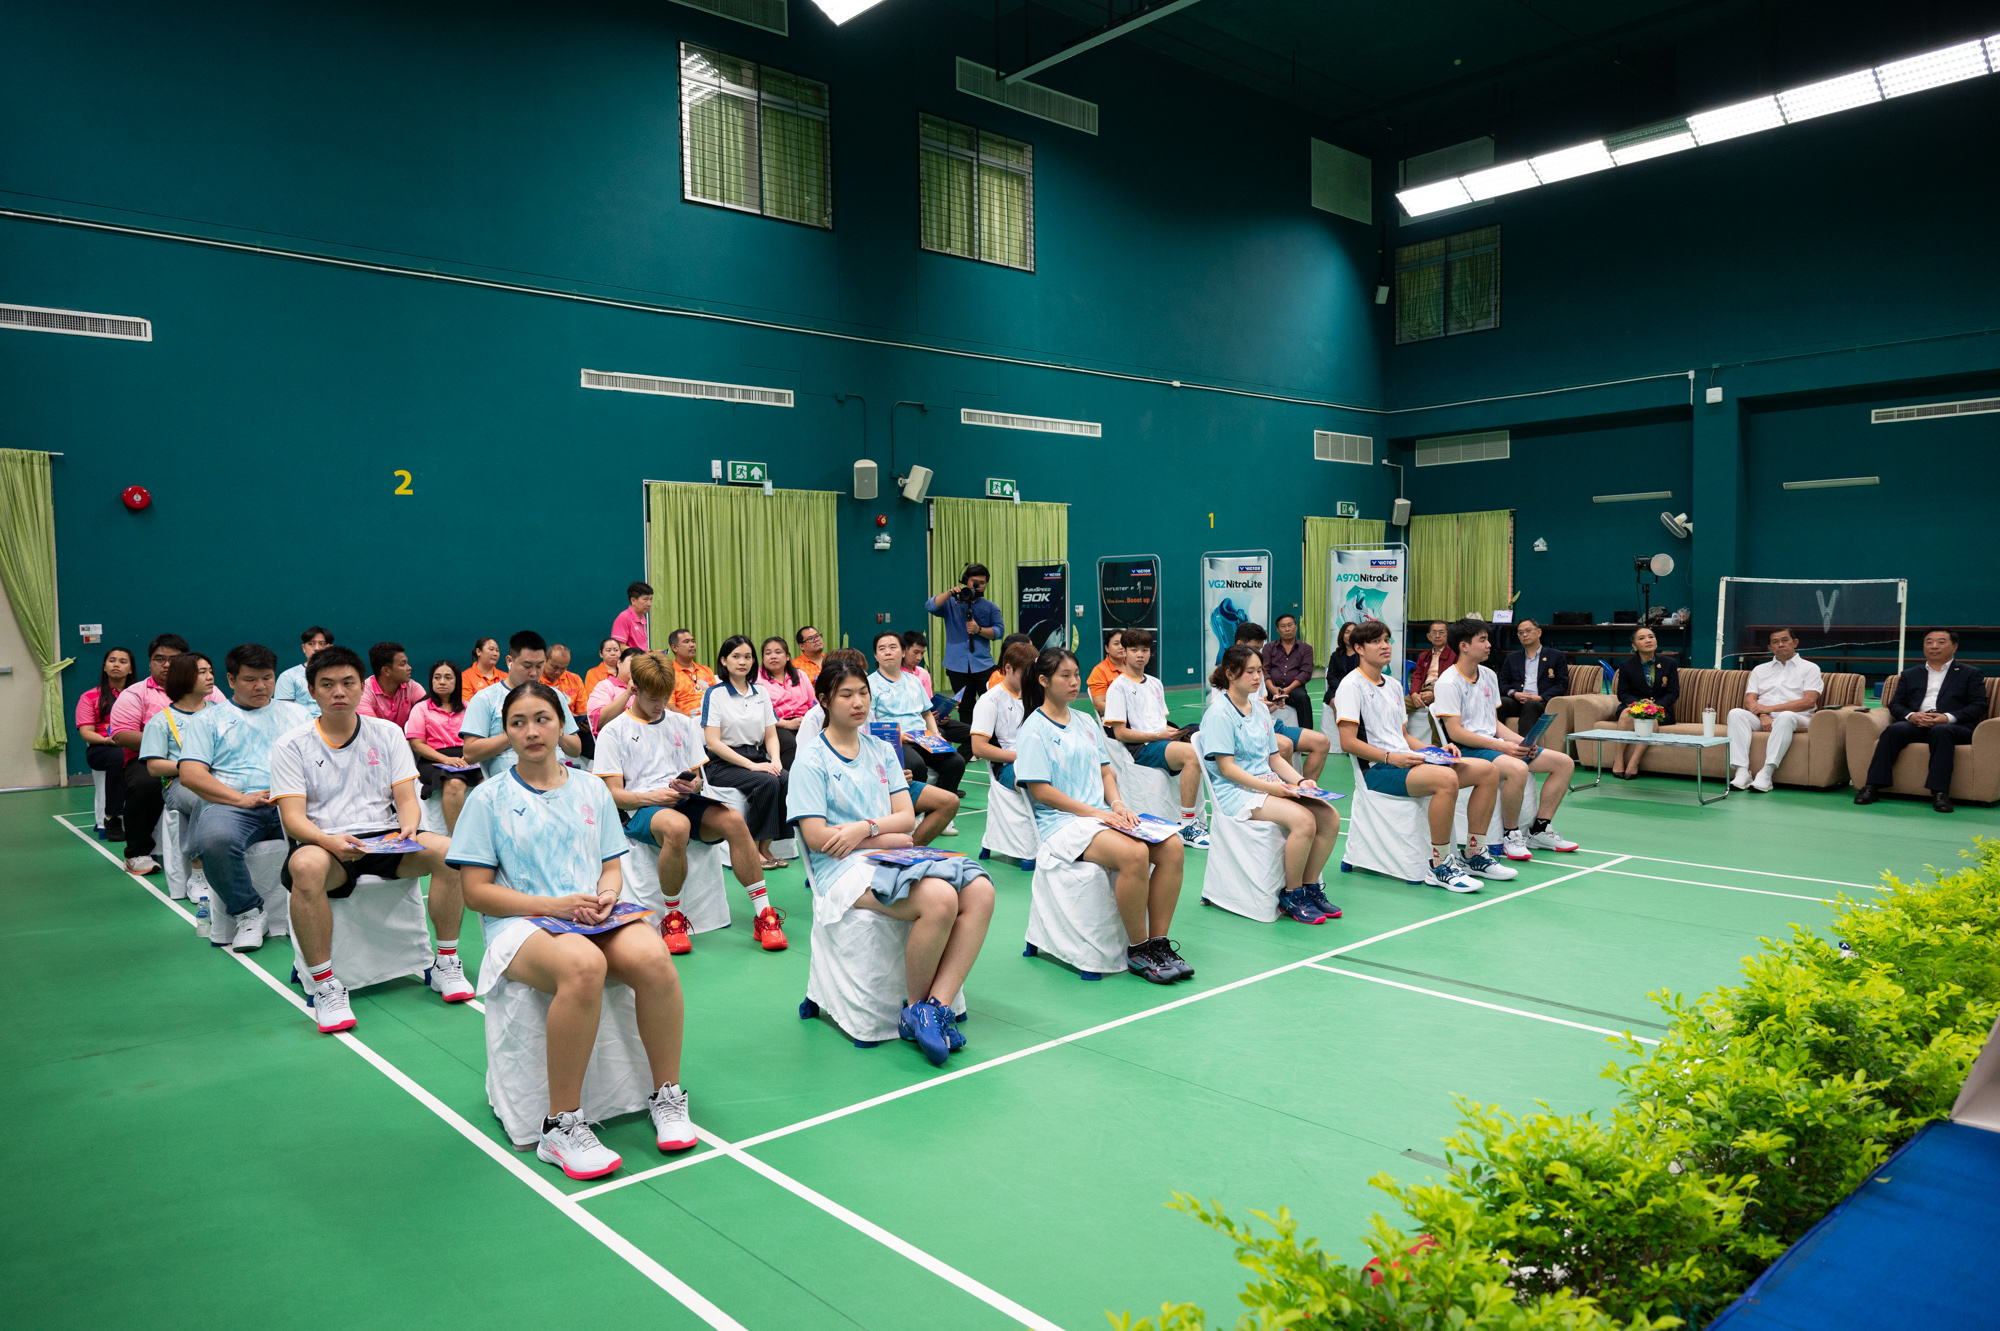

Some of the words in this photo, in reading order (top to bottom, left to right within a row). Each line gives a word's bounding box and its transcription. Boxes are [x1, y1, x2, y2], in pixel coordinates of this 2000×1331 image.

[393, 469, 414, 496] 2
[1208, 512, 1215, 529] 1
[1022, 593, 1050, 602] 90K
